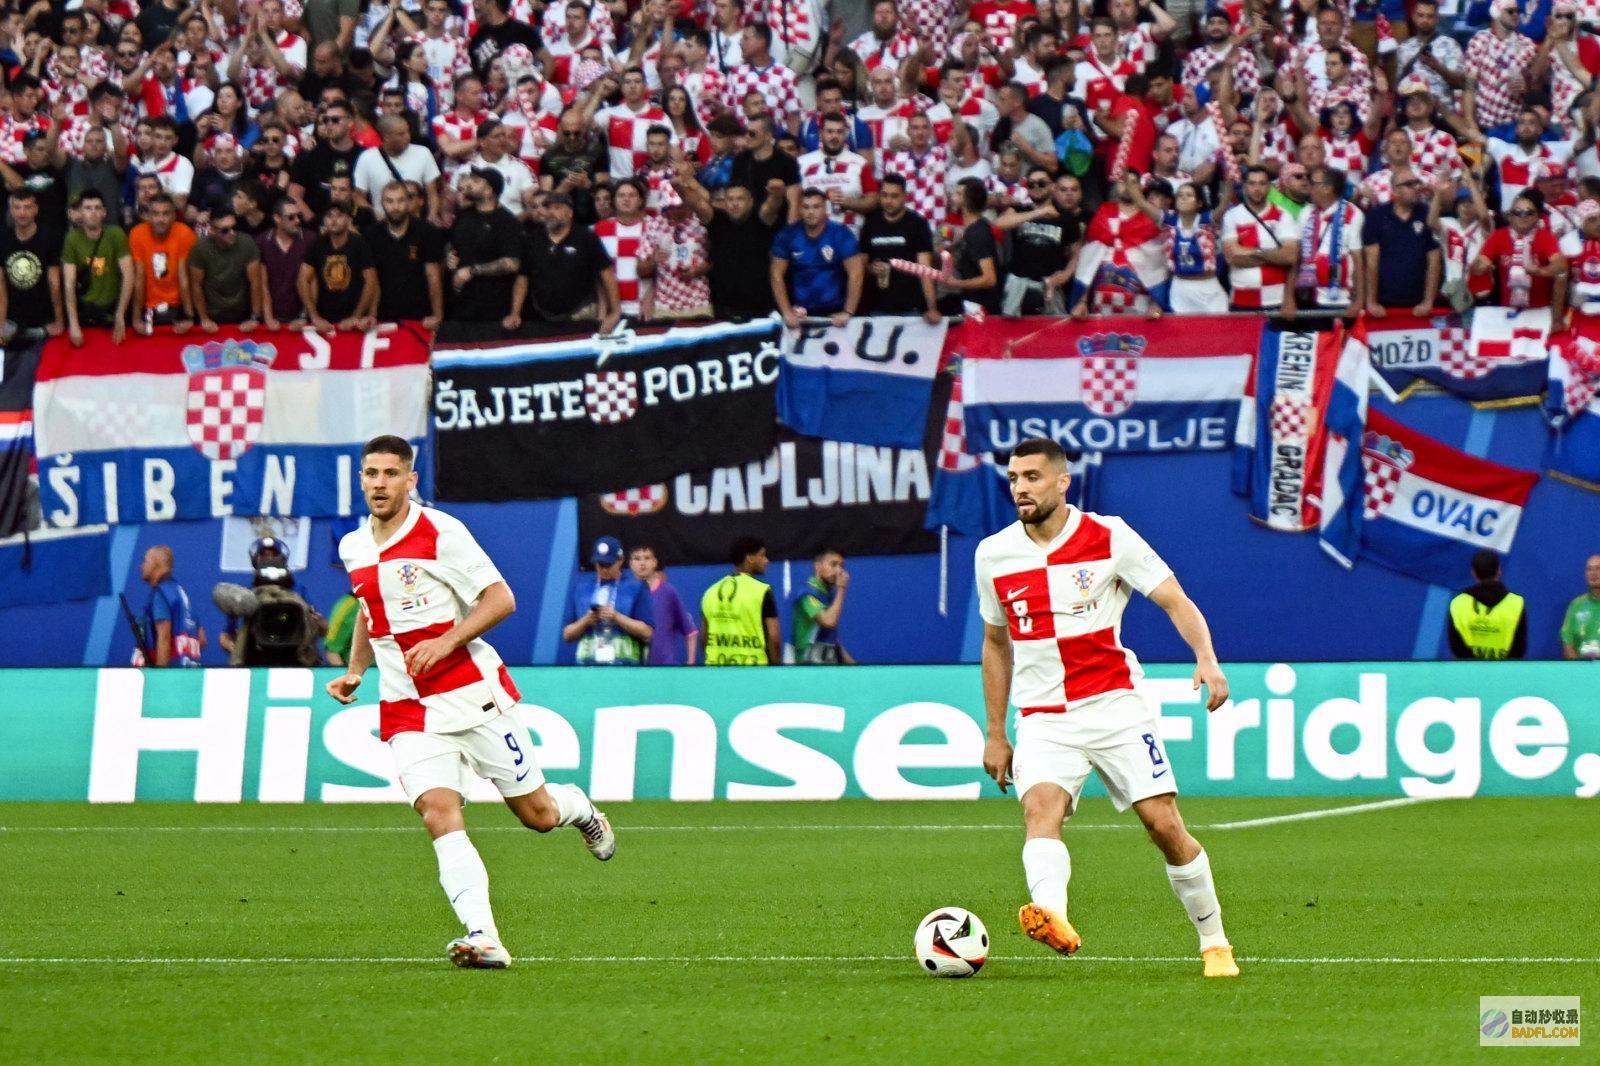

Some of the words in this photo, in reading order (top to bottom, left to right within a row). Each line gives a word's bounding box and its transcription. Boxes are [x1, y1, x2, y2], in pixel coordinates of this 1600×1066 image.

[435, 379, 585, 430] ŠAJETE
[643, 341, 780, 406] POREČ
[989, 417, 1227, 448] USKOPLJE
[47, 448, 420, 528] ŠIBENI
[1271, 445, 1303, 516] GRADAC
[1011, 599, 1034, 634] 8
[504, 732, 524, 766] 9
[1142, 733, 1164, 765] 8
